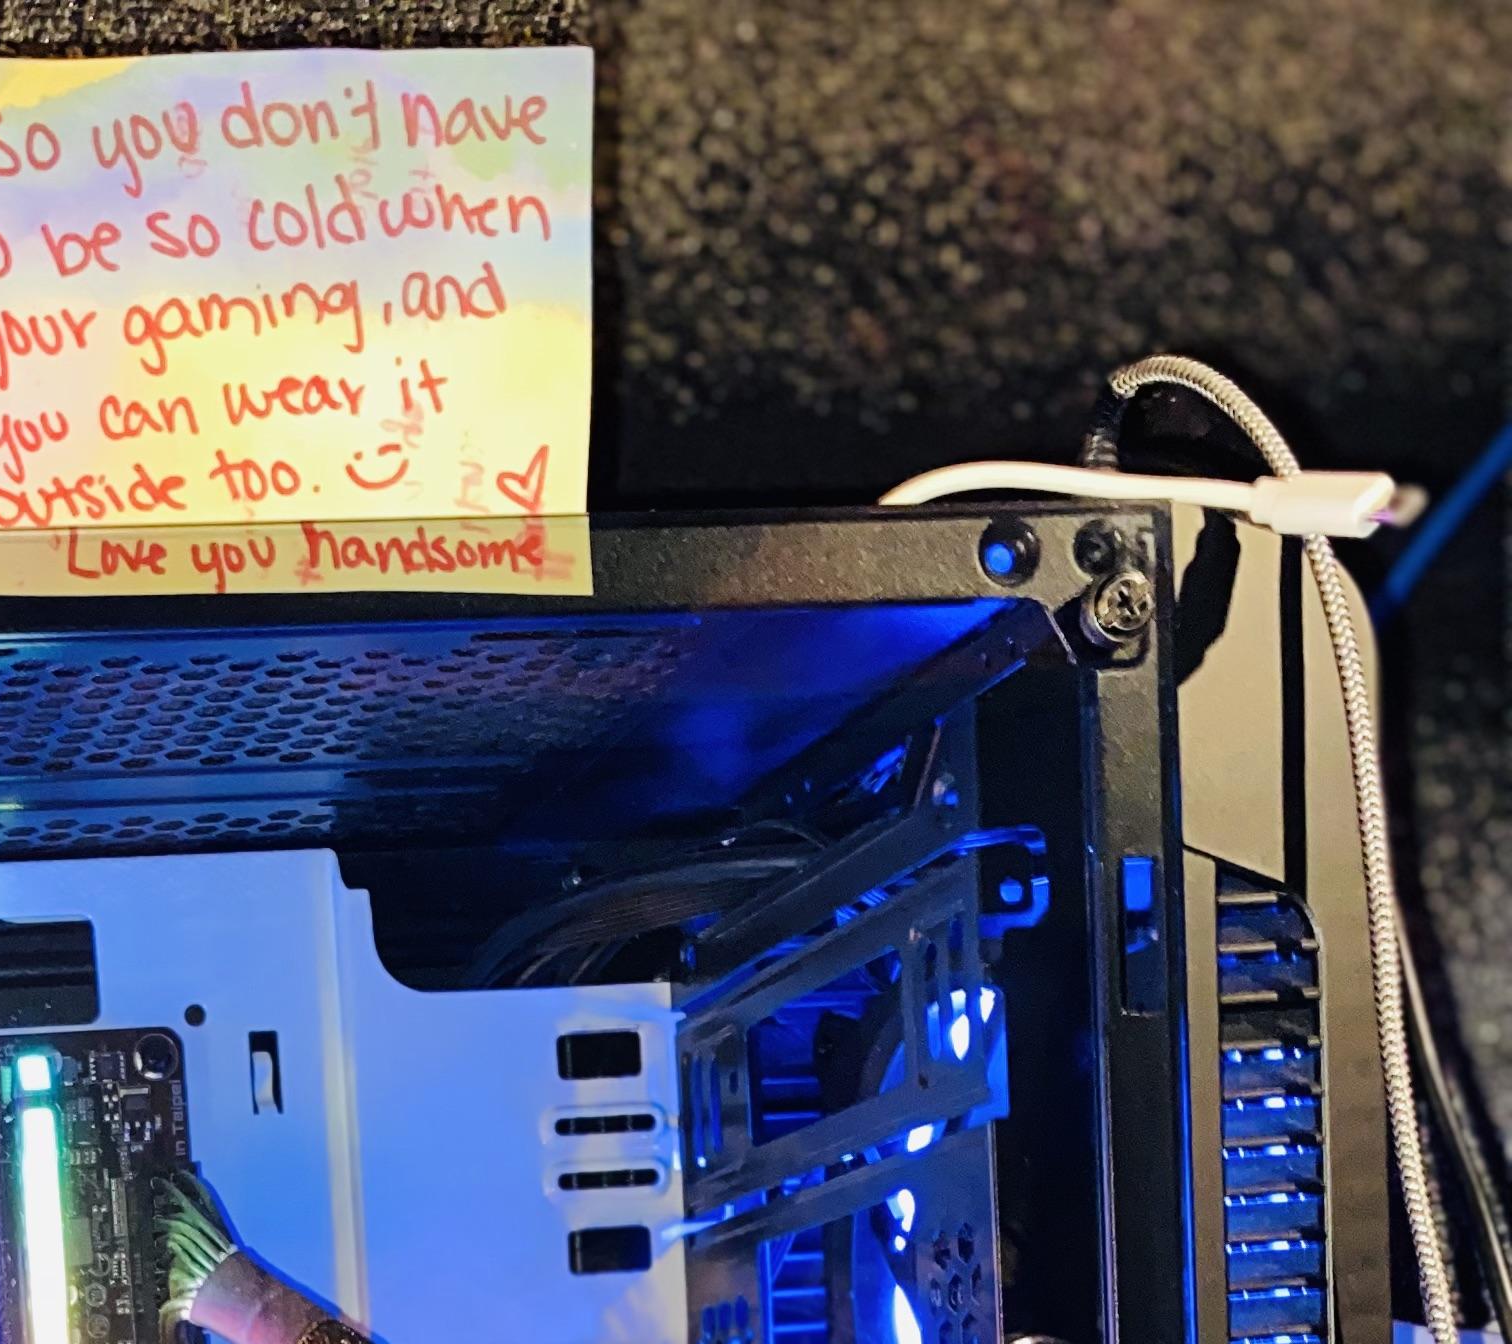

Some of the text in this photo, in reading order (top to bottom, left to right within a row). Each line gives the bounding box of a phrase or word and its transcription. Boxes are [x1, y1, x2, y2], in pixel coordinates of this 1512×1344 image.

[92, 102, 200, 198] you
[220, 80, 379, 151] don't
[401, 93, 548, 148] have
[42, 224, 121, 278] be
[146, 211, 221, 258] so
[247, 174, 367, 251] cold
[377, 184, 551, 242] when
[401, 262, 507, 323] and
[98, 393, 200, 442] can
[222, 376, 365, 426] wear
[394, 357, 449, 416] it
[209, 449, 323, 502] too.
[67, 520, 547, 593] Love you handsome
